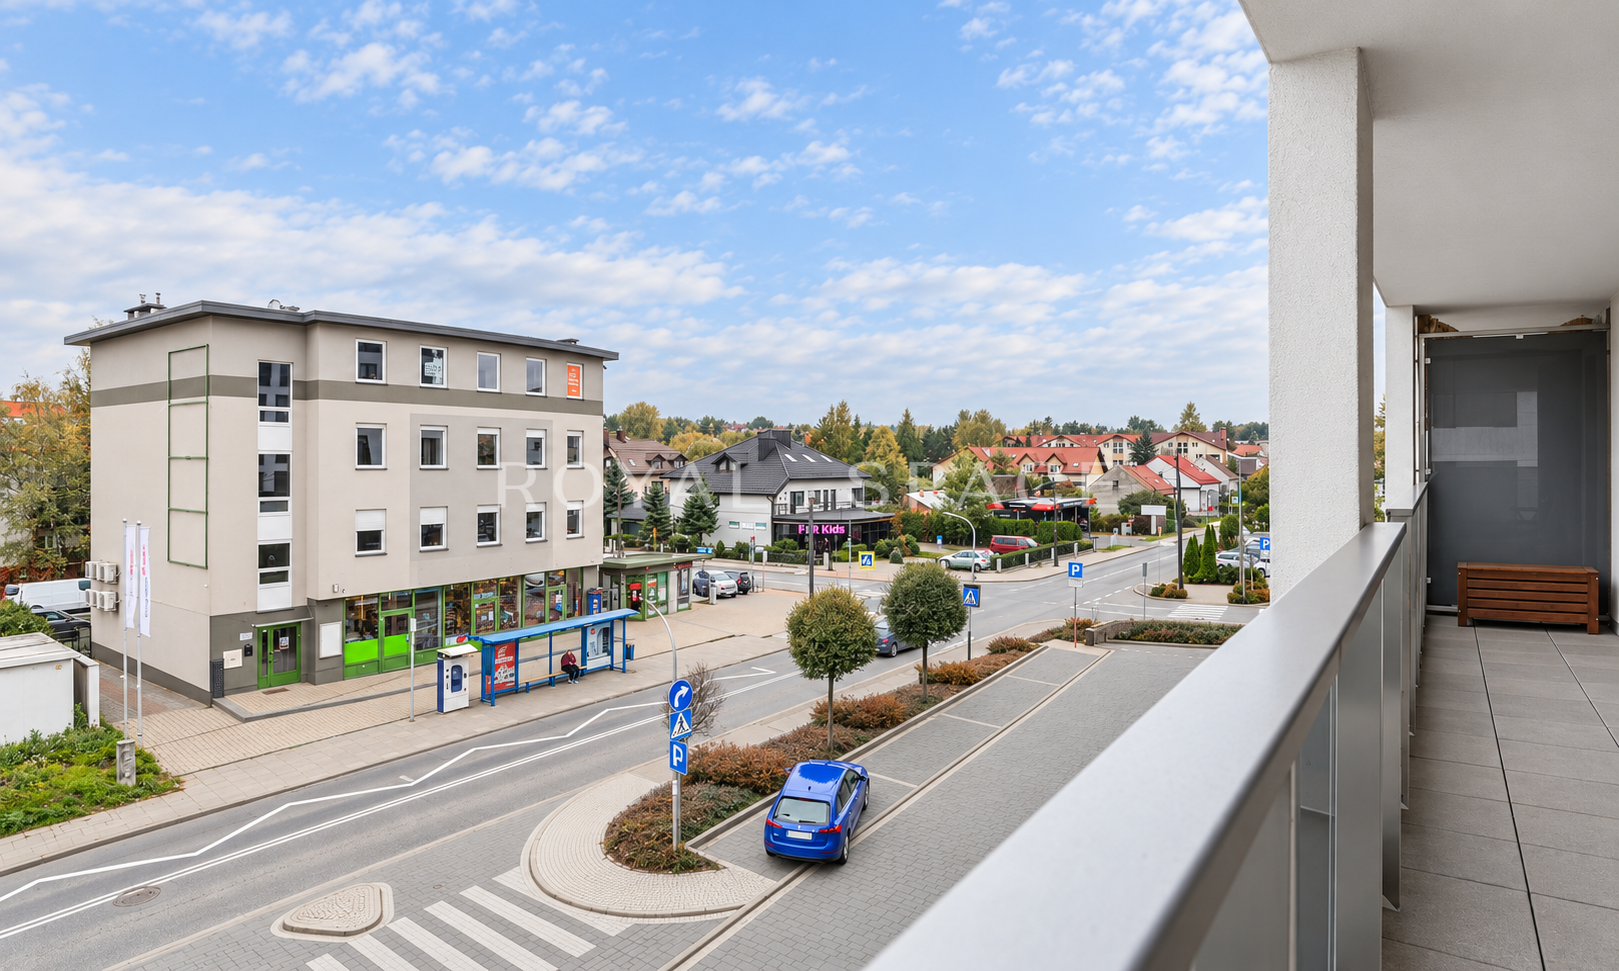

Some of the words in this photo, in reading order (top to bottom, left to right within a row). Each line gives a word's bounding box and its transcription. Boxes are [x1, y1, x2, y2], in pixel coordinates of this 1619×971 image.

[1263, 539, 1270, 549] P
[1071, 564, 1080, 576] P
[673, 744, 683, 766] P
